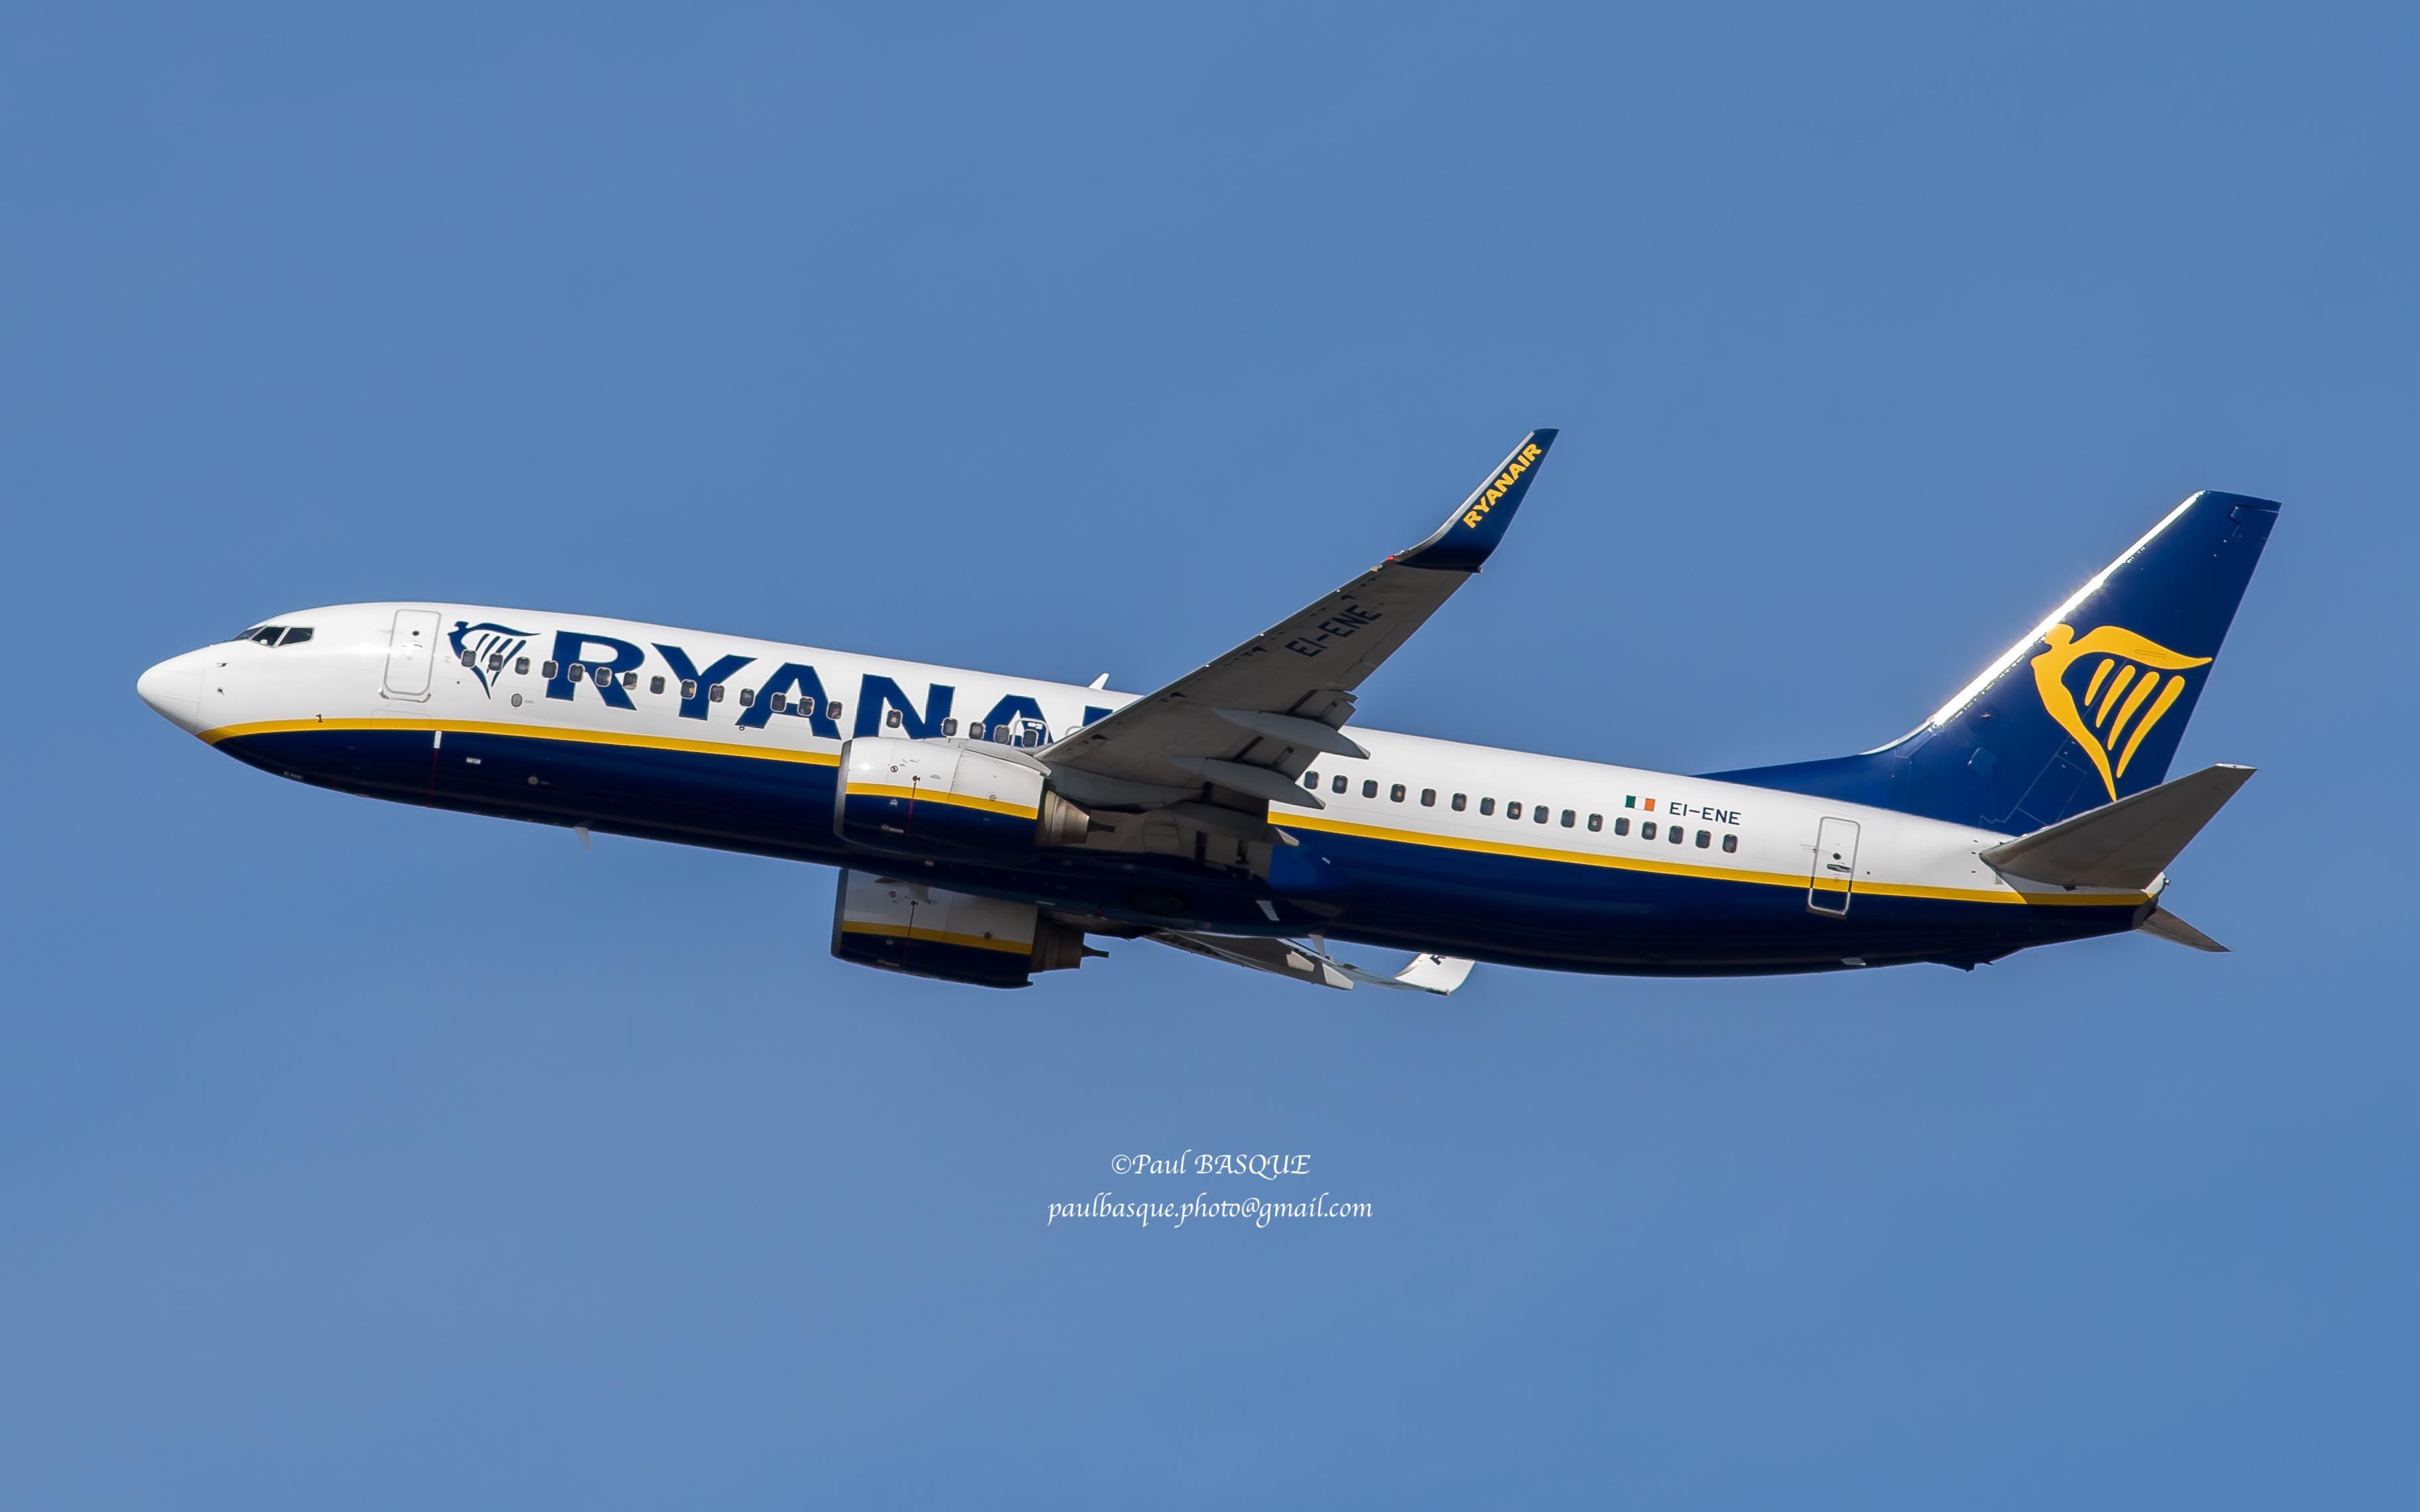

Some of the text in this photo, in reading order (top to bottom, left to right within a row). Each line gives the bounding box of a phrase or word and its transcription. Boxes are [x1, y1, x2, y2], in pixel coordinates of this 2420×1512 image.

[1463, 444, 1542, 528] RYANAIR
[1286, 605, 1382, 657] EI-ENE
[545, 630, 1113, 746] RYANA
[1670, 802, 1741, 826] EI-ENE
